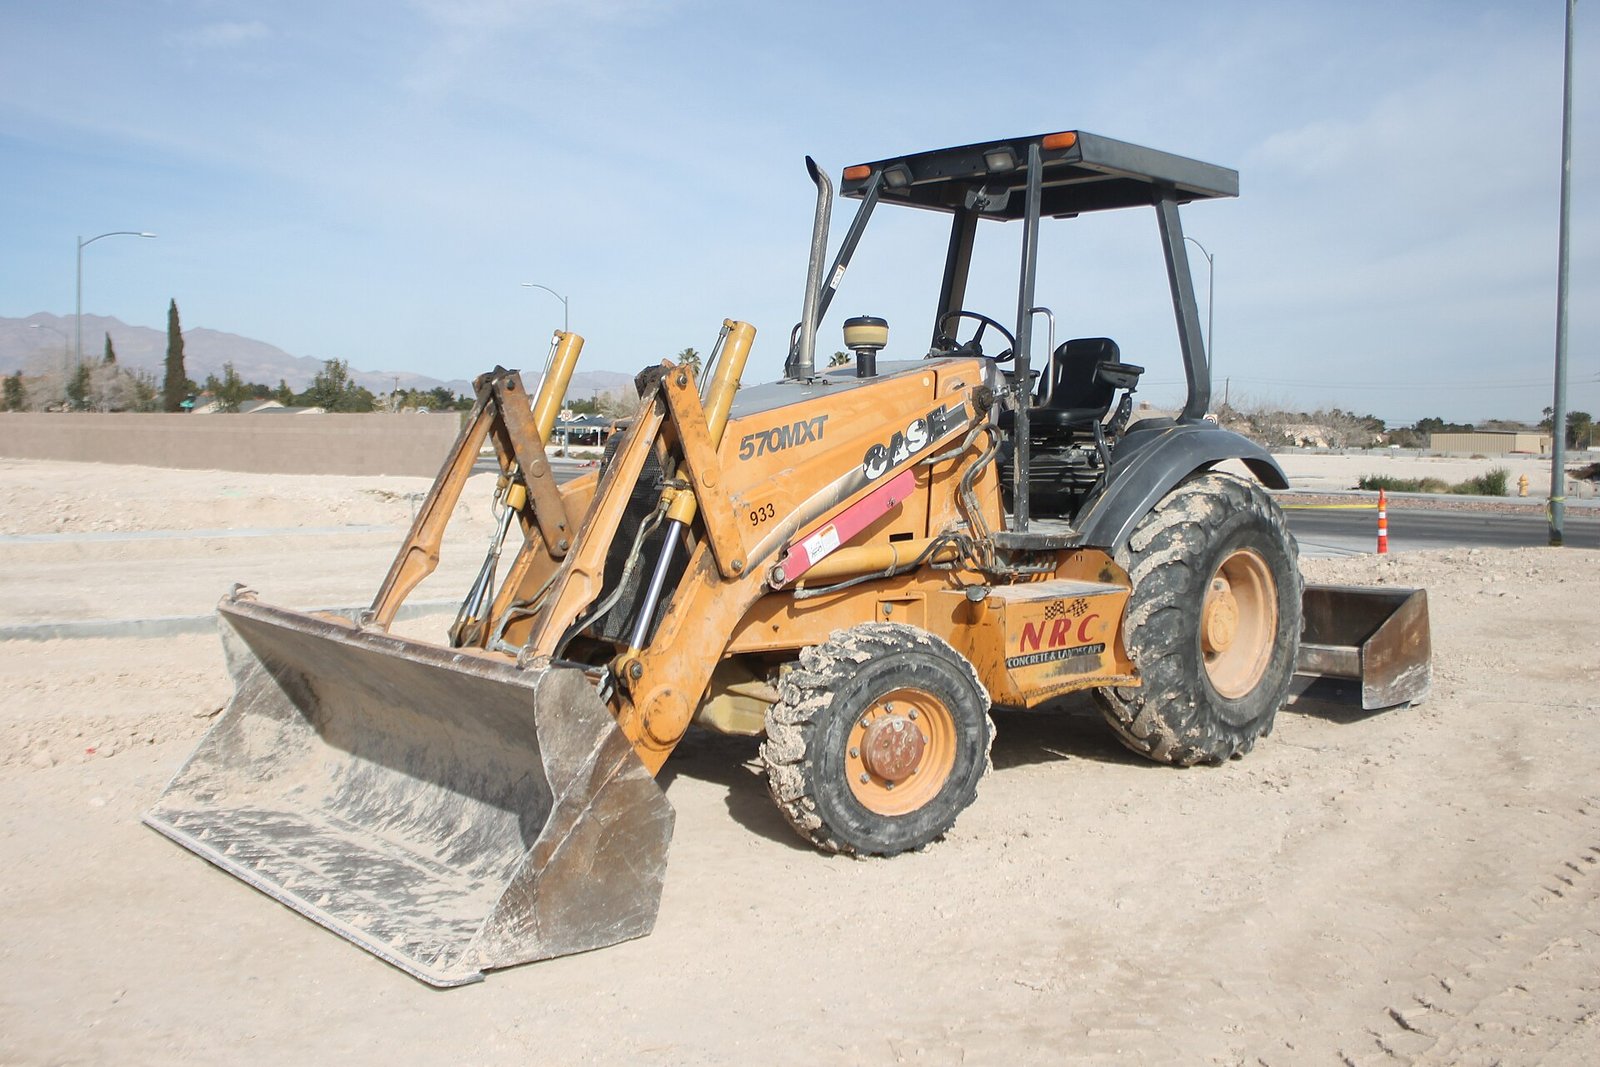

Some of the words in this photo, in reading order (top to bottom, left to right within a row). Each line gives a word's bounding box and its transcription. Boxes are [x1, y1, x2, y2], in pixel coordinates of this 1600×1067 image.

[739, 415, 828, 460] 570MXT
[750, 503, 776, 526] 933
[1020, 614, 1099, 652] NRC
[1008, 653, 1049, 667] CONCRETE
